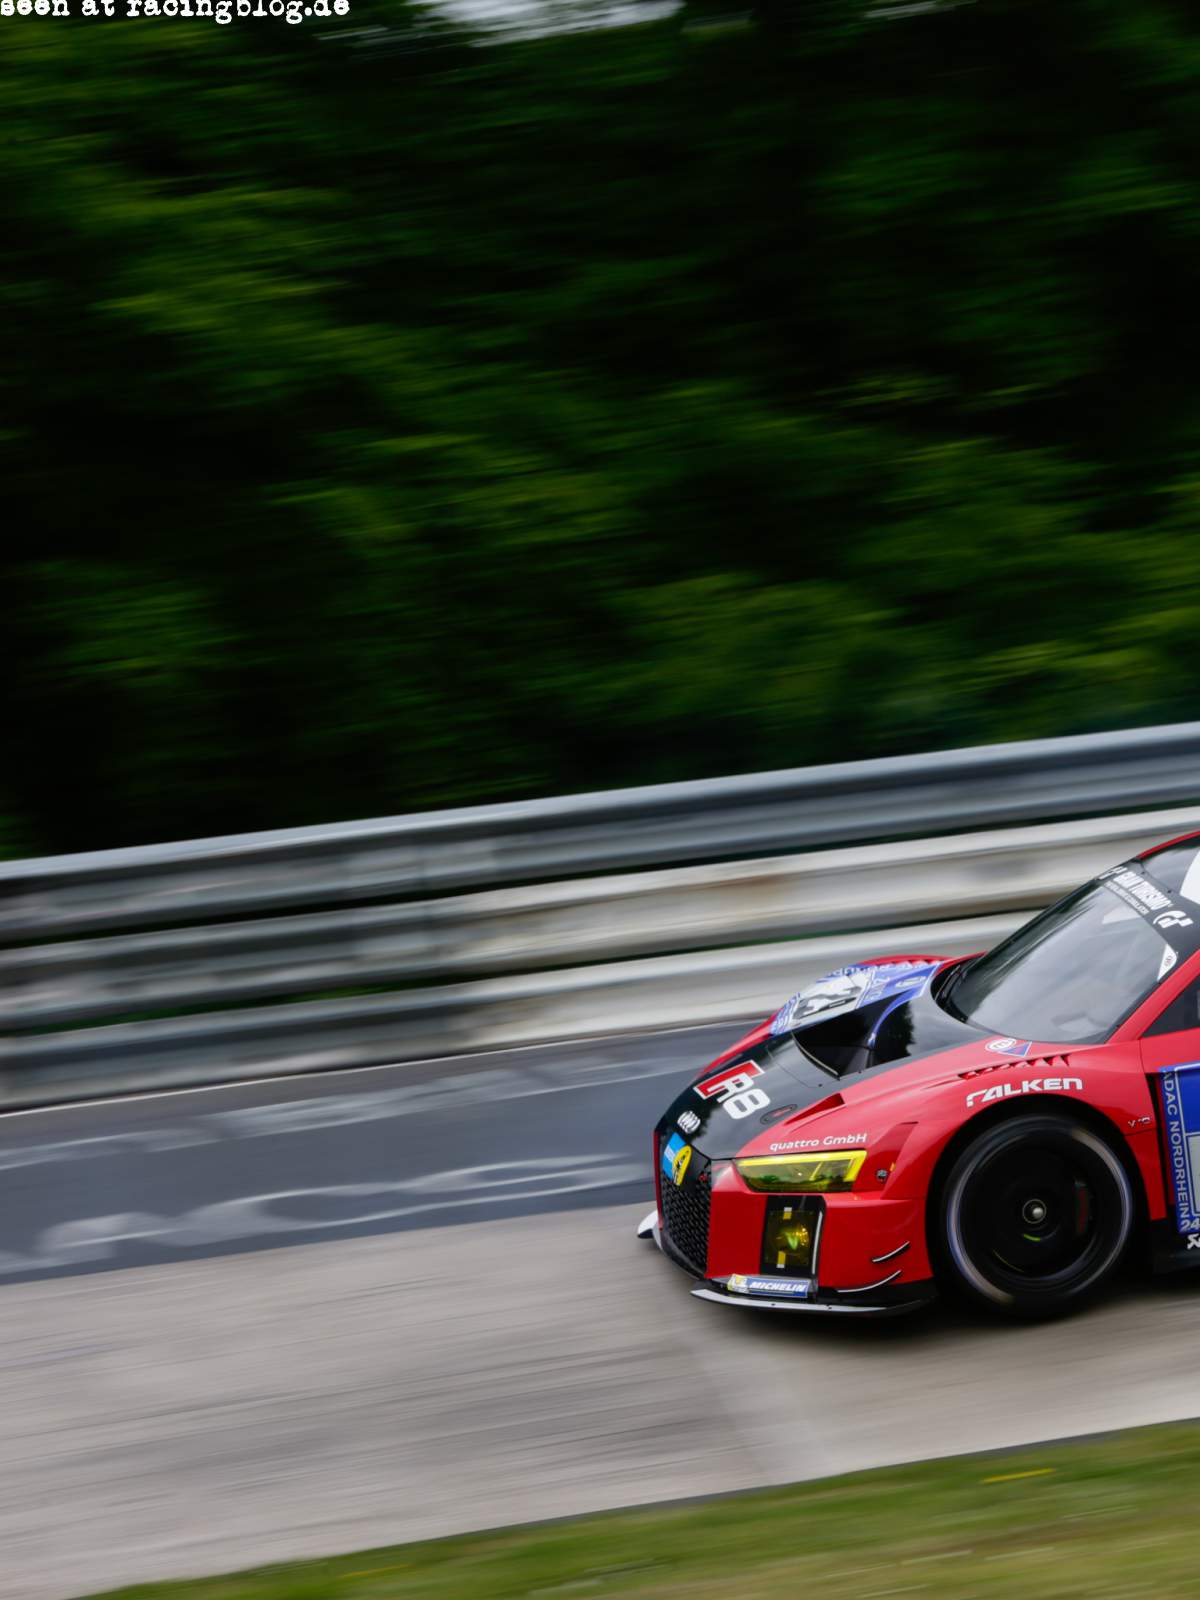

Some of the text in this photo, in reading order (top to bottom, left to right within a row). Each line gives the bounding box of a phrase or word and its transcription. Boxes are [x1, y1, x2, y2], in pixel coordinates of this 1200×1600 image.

[706, 1072, 772, 1120] R8
[966, 1077, 1083, 1108] FALKEN
[769, 1133, 868, 1151] quattro GmbH
[1163, 1070, 1191, 1219] ADAC NORDRHEIN
[749, 1280, 807, 1292] MICHELIN
